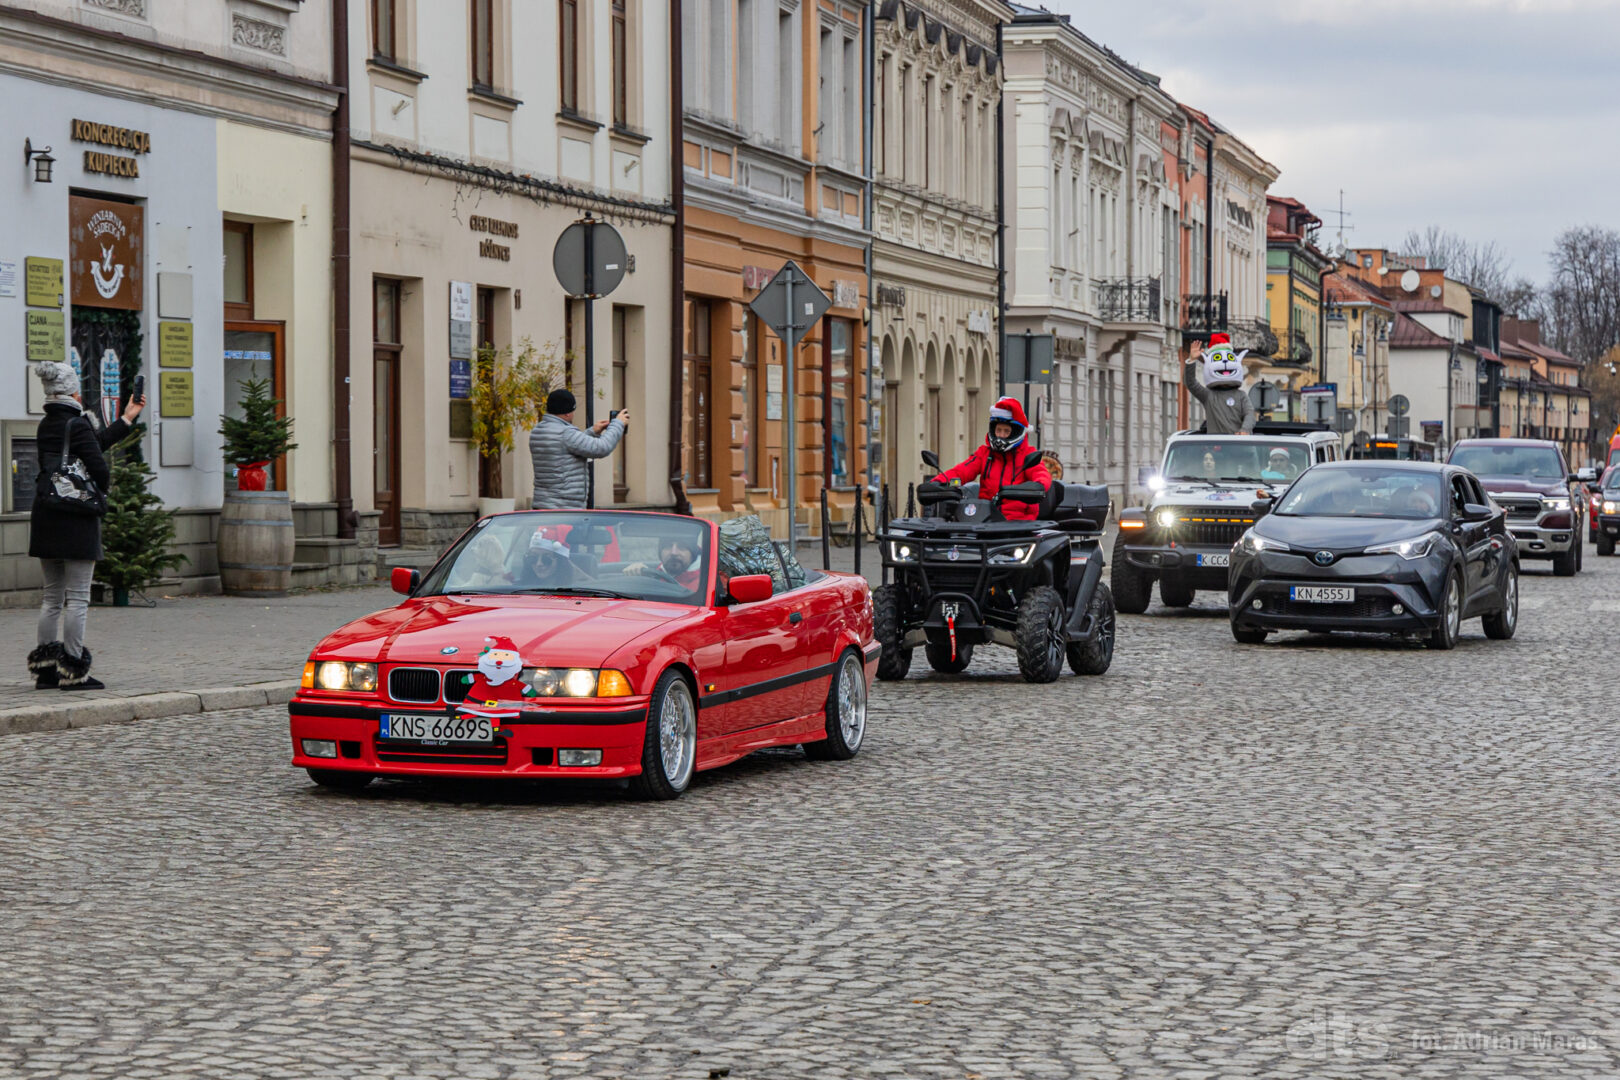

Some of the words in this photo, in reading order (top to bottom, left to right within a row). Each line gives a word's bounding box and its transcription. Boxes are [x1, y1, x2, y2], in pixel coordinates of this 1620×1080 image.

[72, 118, 151, 153] KONGREGACJA
[84, 151, 139, 178] KUPIECKA
[1202, 556, 1208, 565] K
[1298, 589, 1313, 600] KN
[1317, 588, 1351, 601] 4555J
[390, 716, 426, 738] KNS
[432, 718, 490, 740] 6669S
